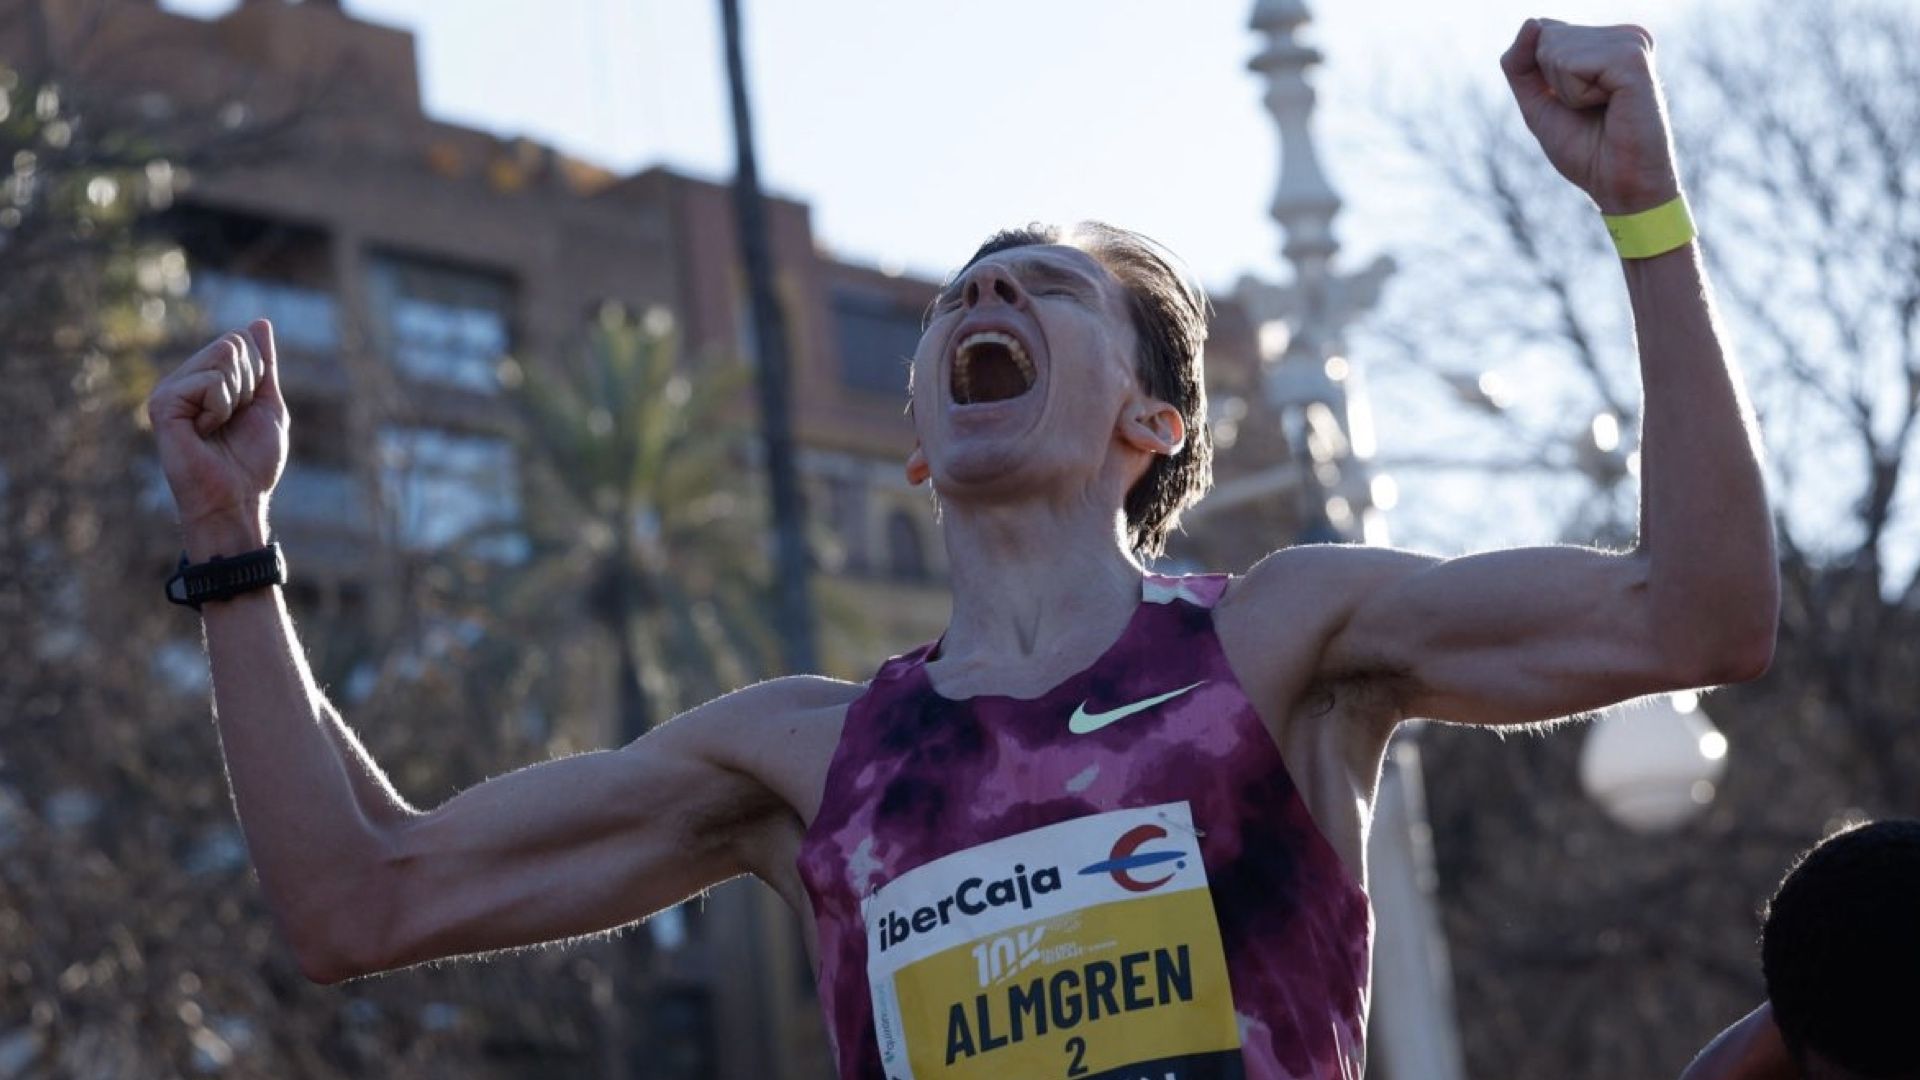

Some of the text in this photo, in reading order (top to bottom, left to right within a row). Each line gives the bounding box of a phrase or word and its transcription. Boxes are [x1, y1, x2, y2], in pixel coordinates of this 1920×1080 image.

[878, 864, 1062, 952] iberCaja
[971, 926, 1047, 988] 10K
[945, 944, 1193, 1066] ALMGREN
[1065, 1036, 1089, 1078] 2
